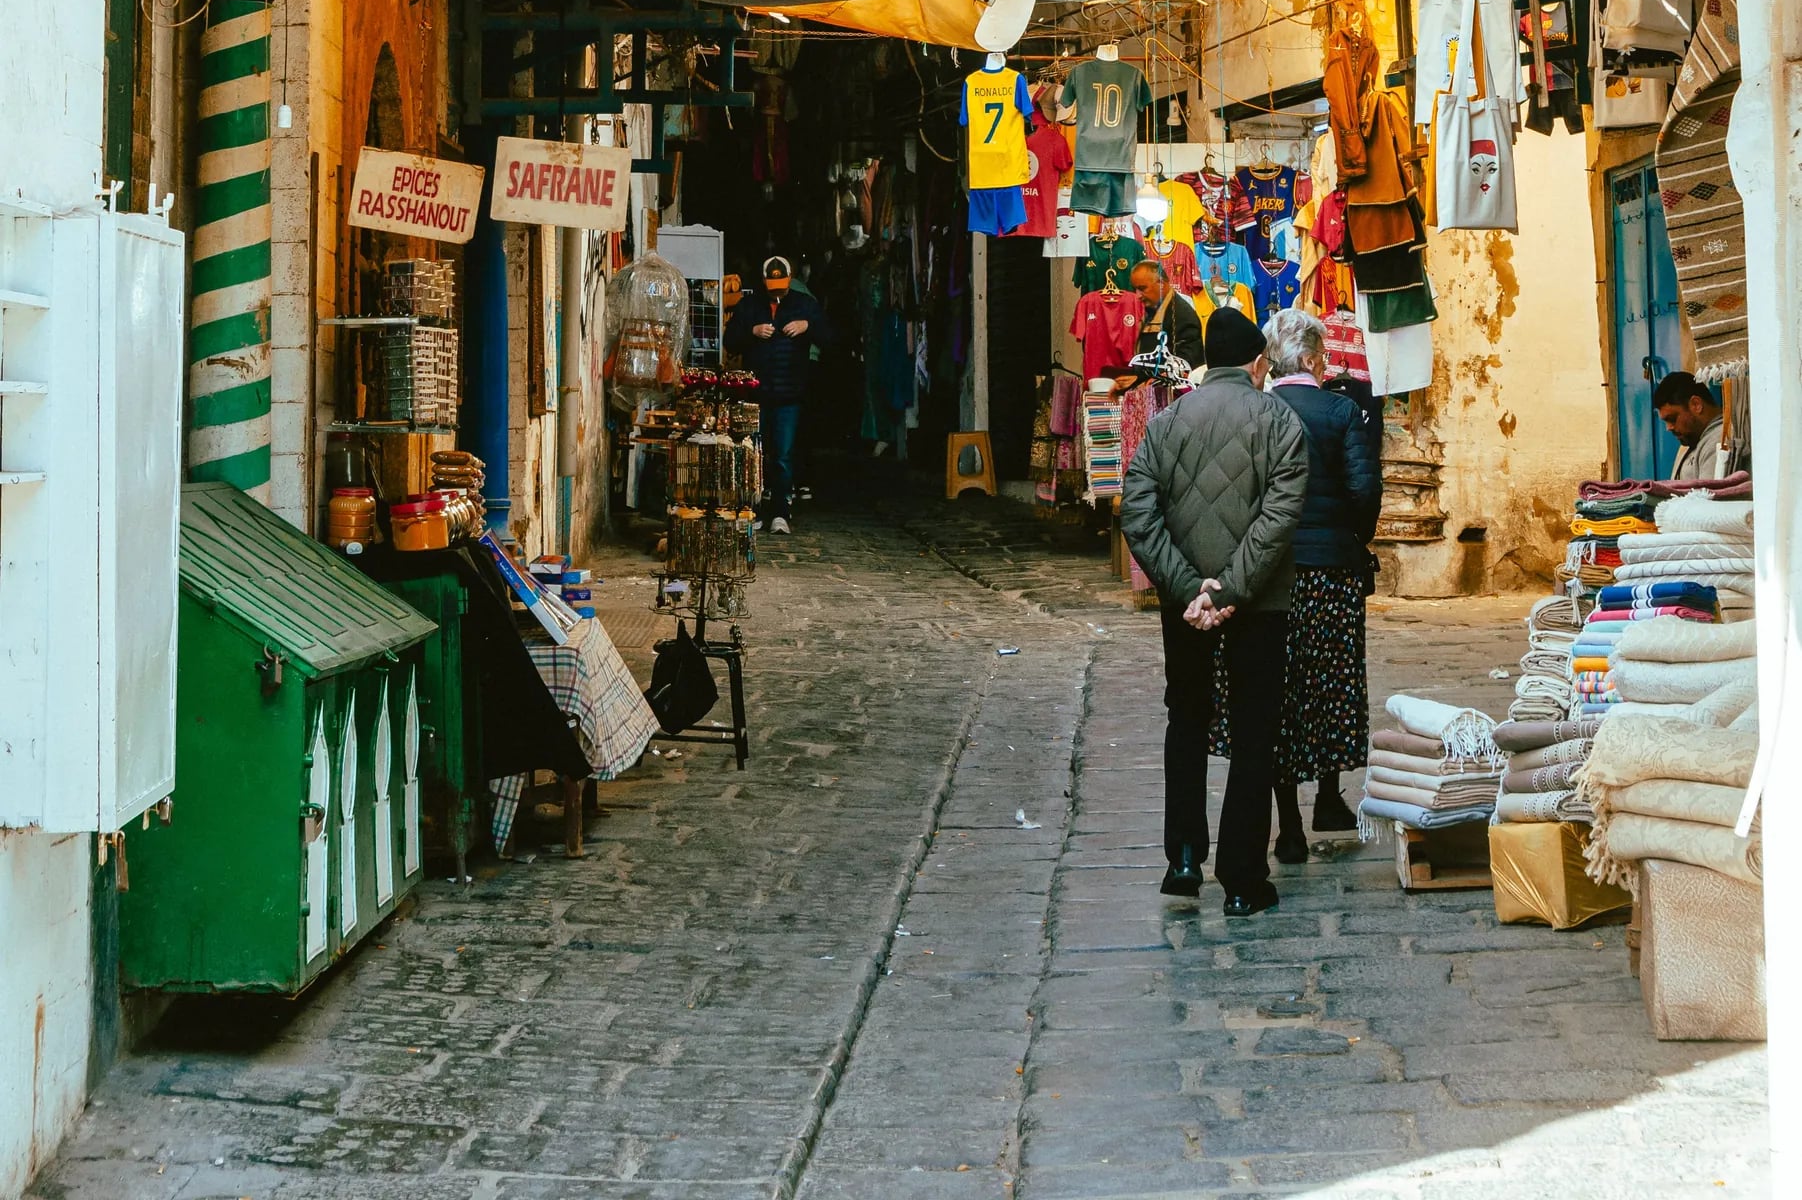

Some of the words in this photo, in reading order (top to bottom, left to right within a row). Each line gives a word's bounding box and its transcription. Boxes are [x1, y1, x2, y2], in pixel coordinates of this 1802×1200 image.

[984, 102, 1004, 144] 7
[1092, 83, 1122, 128] 10
[392, 166, 441, 198] EPICES
[506, 160, 616, 207] SAFRANE
[1021, 187, 1039, 196] ISIA
[358, 189, 471, 233] RASSHANOUT
[1102, 223, 1127, 234] ATAR
